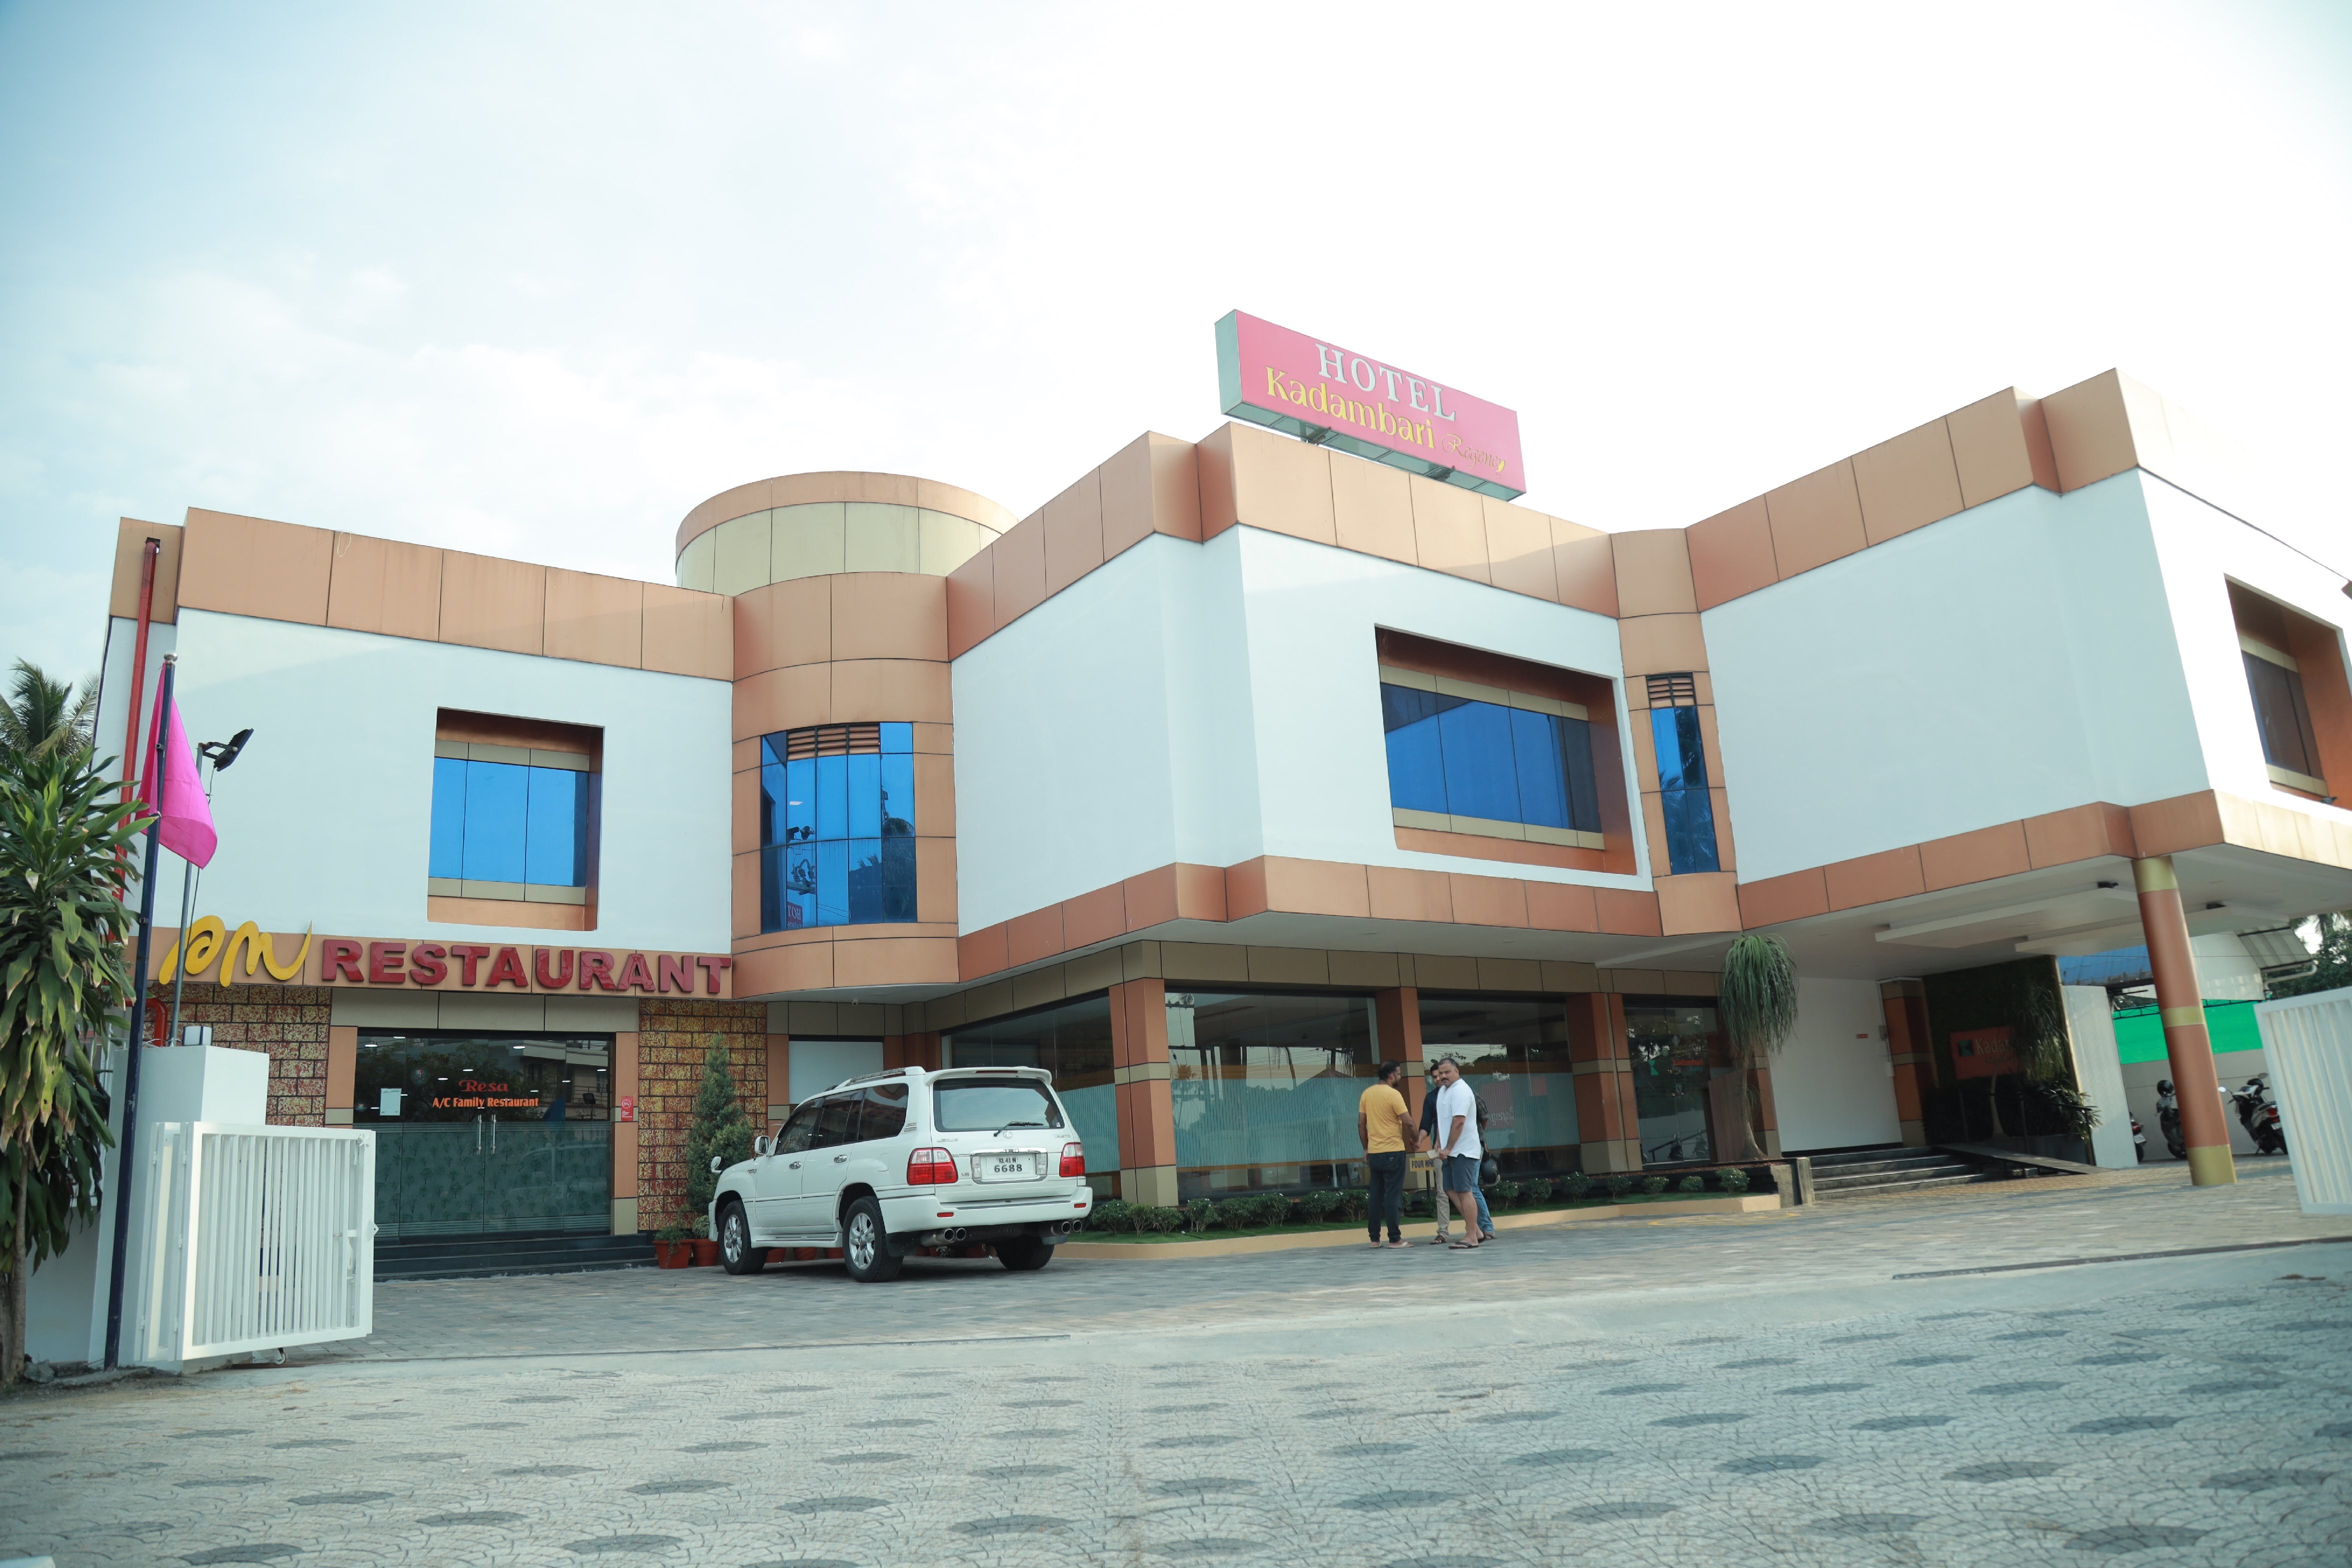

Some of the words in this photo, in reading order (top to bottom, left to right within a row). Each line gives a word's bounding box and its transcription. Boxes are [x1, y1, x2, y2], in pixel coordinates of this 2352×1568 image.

[1315, 342, 1456, 422] HOTEL
[1265, 365, 1435, 449] Kadambari
[1441, 433, 1506, 478] Regency
[322, 938, 732, 994] RESTAURANT
[458, 1080, 510, 1092] Resa
[432, 1098, 451, 1109] A/C
[453, 1097, 485, 1108] Family
[487, 1097, 539, 1107] Restaurant
[994, 1164, 1022, 1172] 6688
[1412, 1160, 1424, 1168] FOUR
